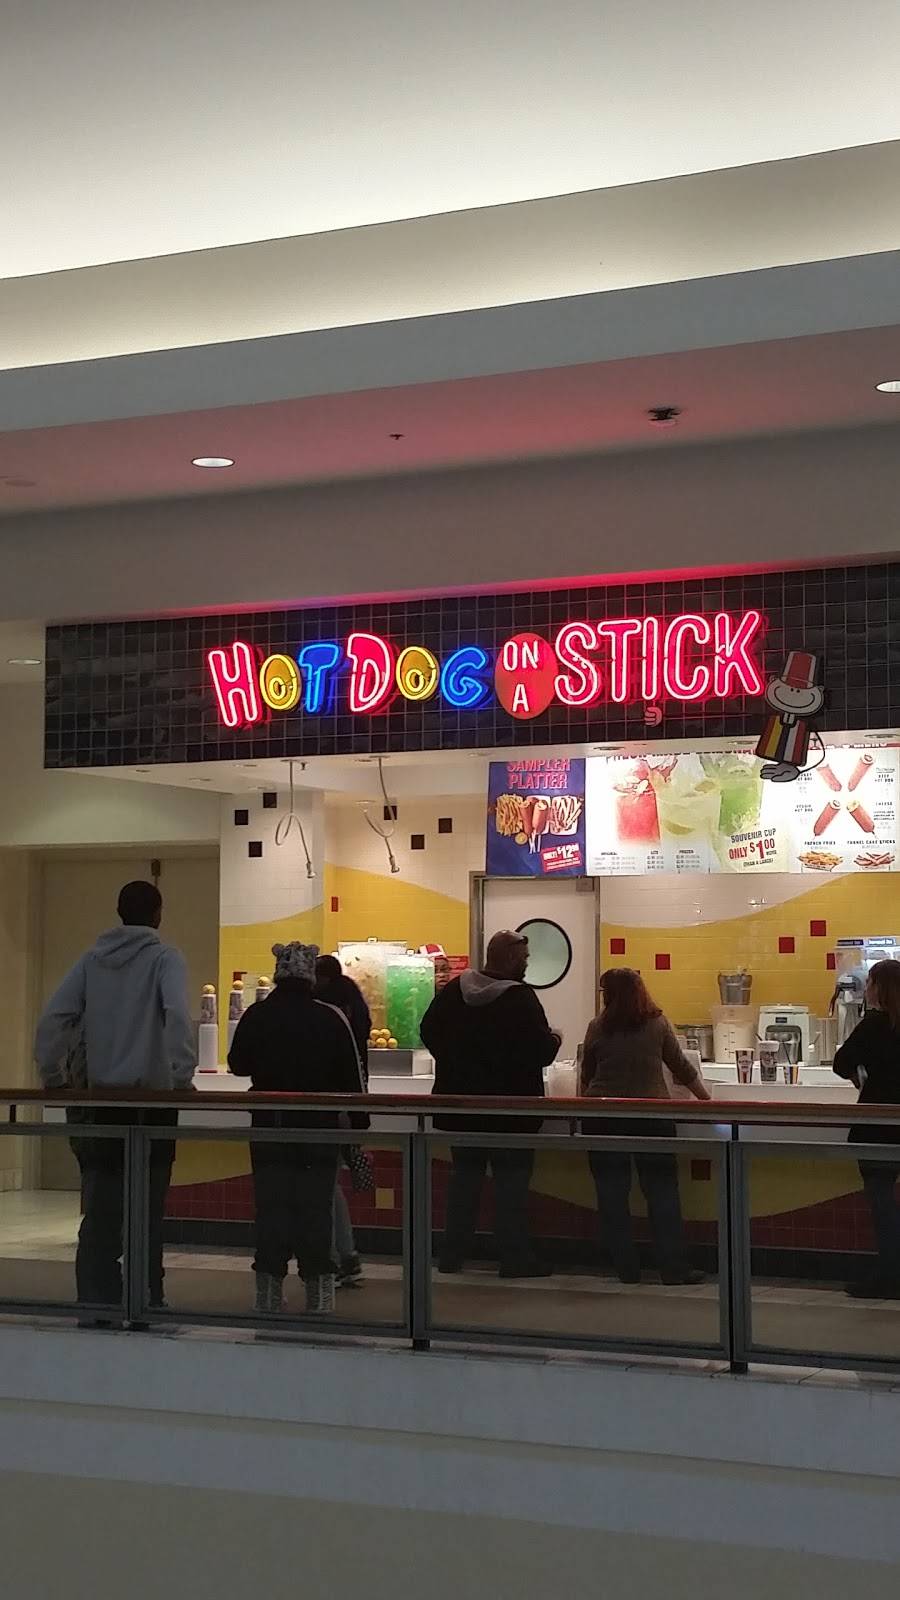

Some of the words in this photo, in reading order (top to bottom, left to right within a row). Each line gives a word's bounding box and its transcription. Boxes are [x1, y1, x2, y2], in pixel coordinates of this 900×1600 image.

[503, 640, 539, 671] ON
[554, 610, 761, 706] STICK
[208, 641, 340, 728] HOT
[347, 632, 487, 712] DOG
[512, 683, 530, 712] A
[507, 759, 570, 772] SAMPLER
[508, 773, 568, 789] PLATTER
[731, 831, 762, 843] SOUVENIR
[764, 828, 776, 837] CUP
[729, 847, 747, 859] ONLY
